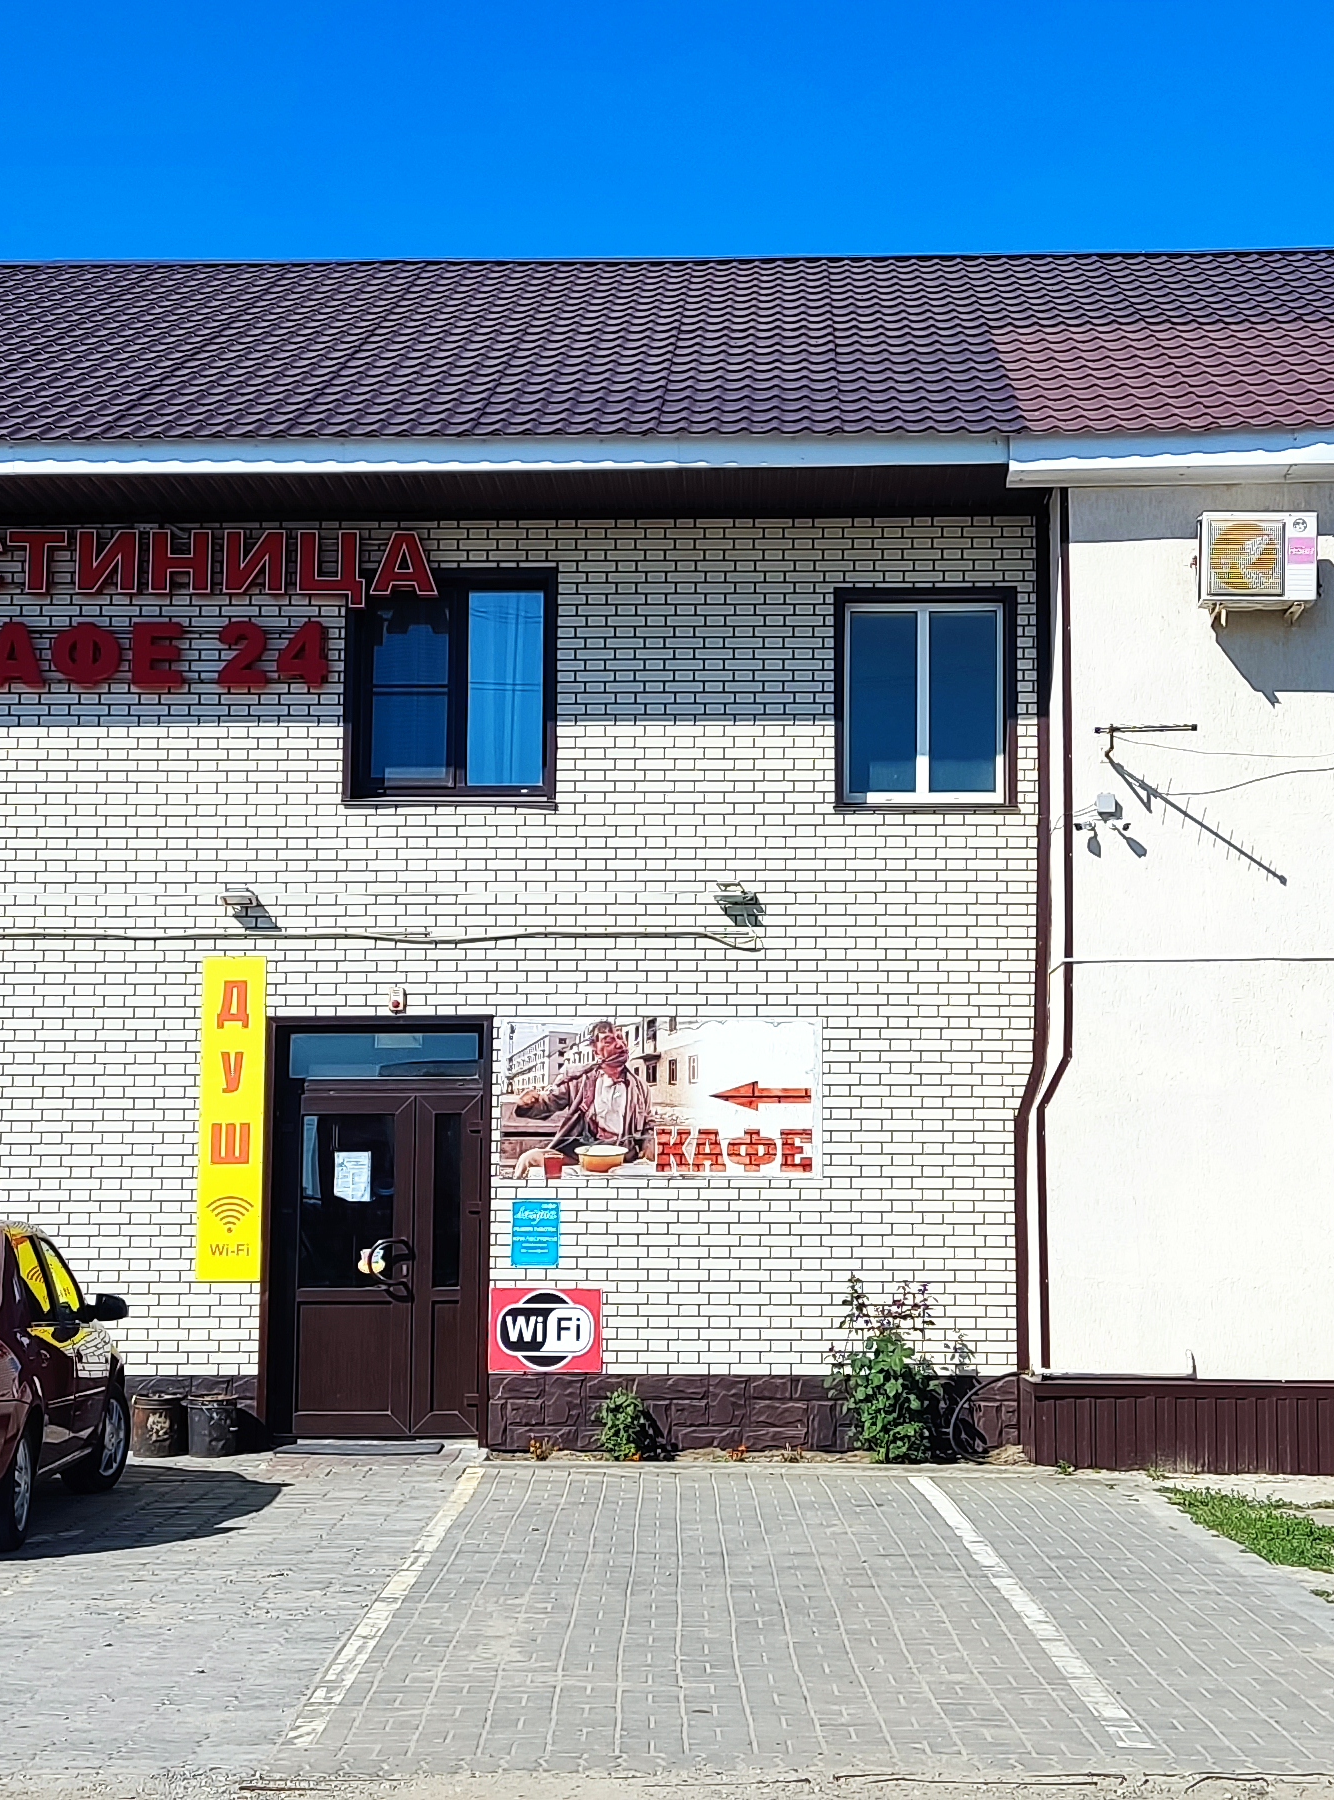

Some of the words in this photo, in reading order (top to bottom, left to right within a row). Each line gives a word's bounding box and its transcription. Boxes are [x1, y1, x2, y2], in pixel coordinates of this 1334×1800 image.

[217, 620, 329, 688] 24
[210, 980, 250, 1165] ДУШ
[655, 1128, 813, 1173] КАФЕ
[210, 1243, 250, 1257] Wi-Fi
